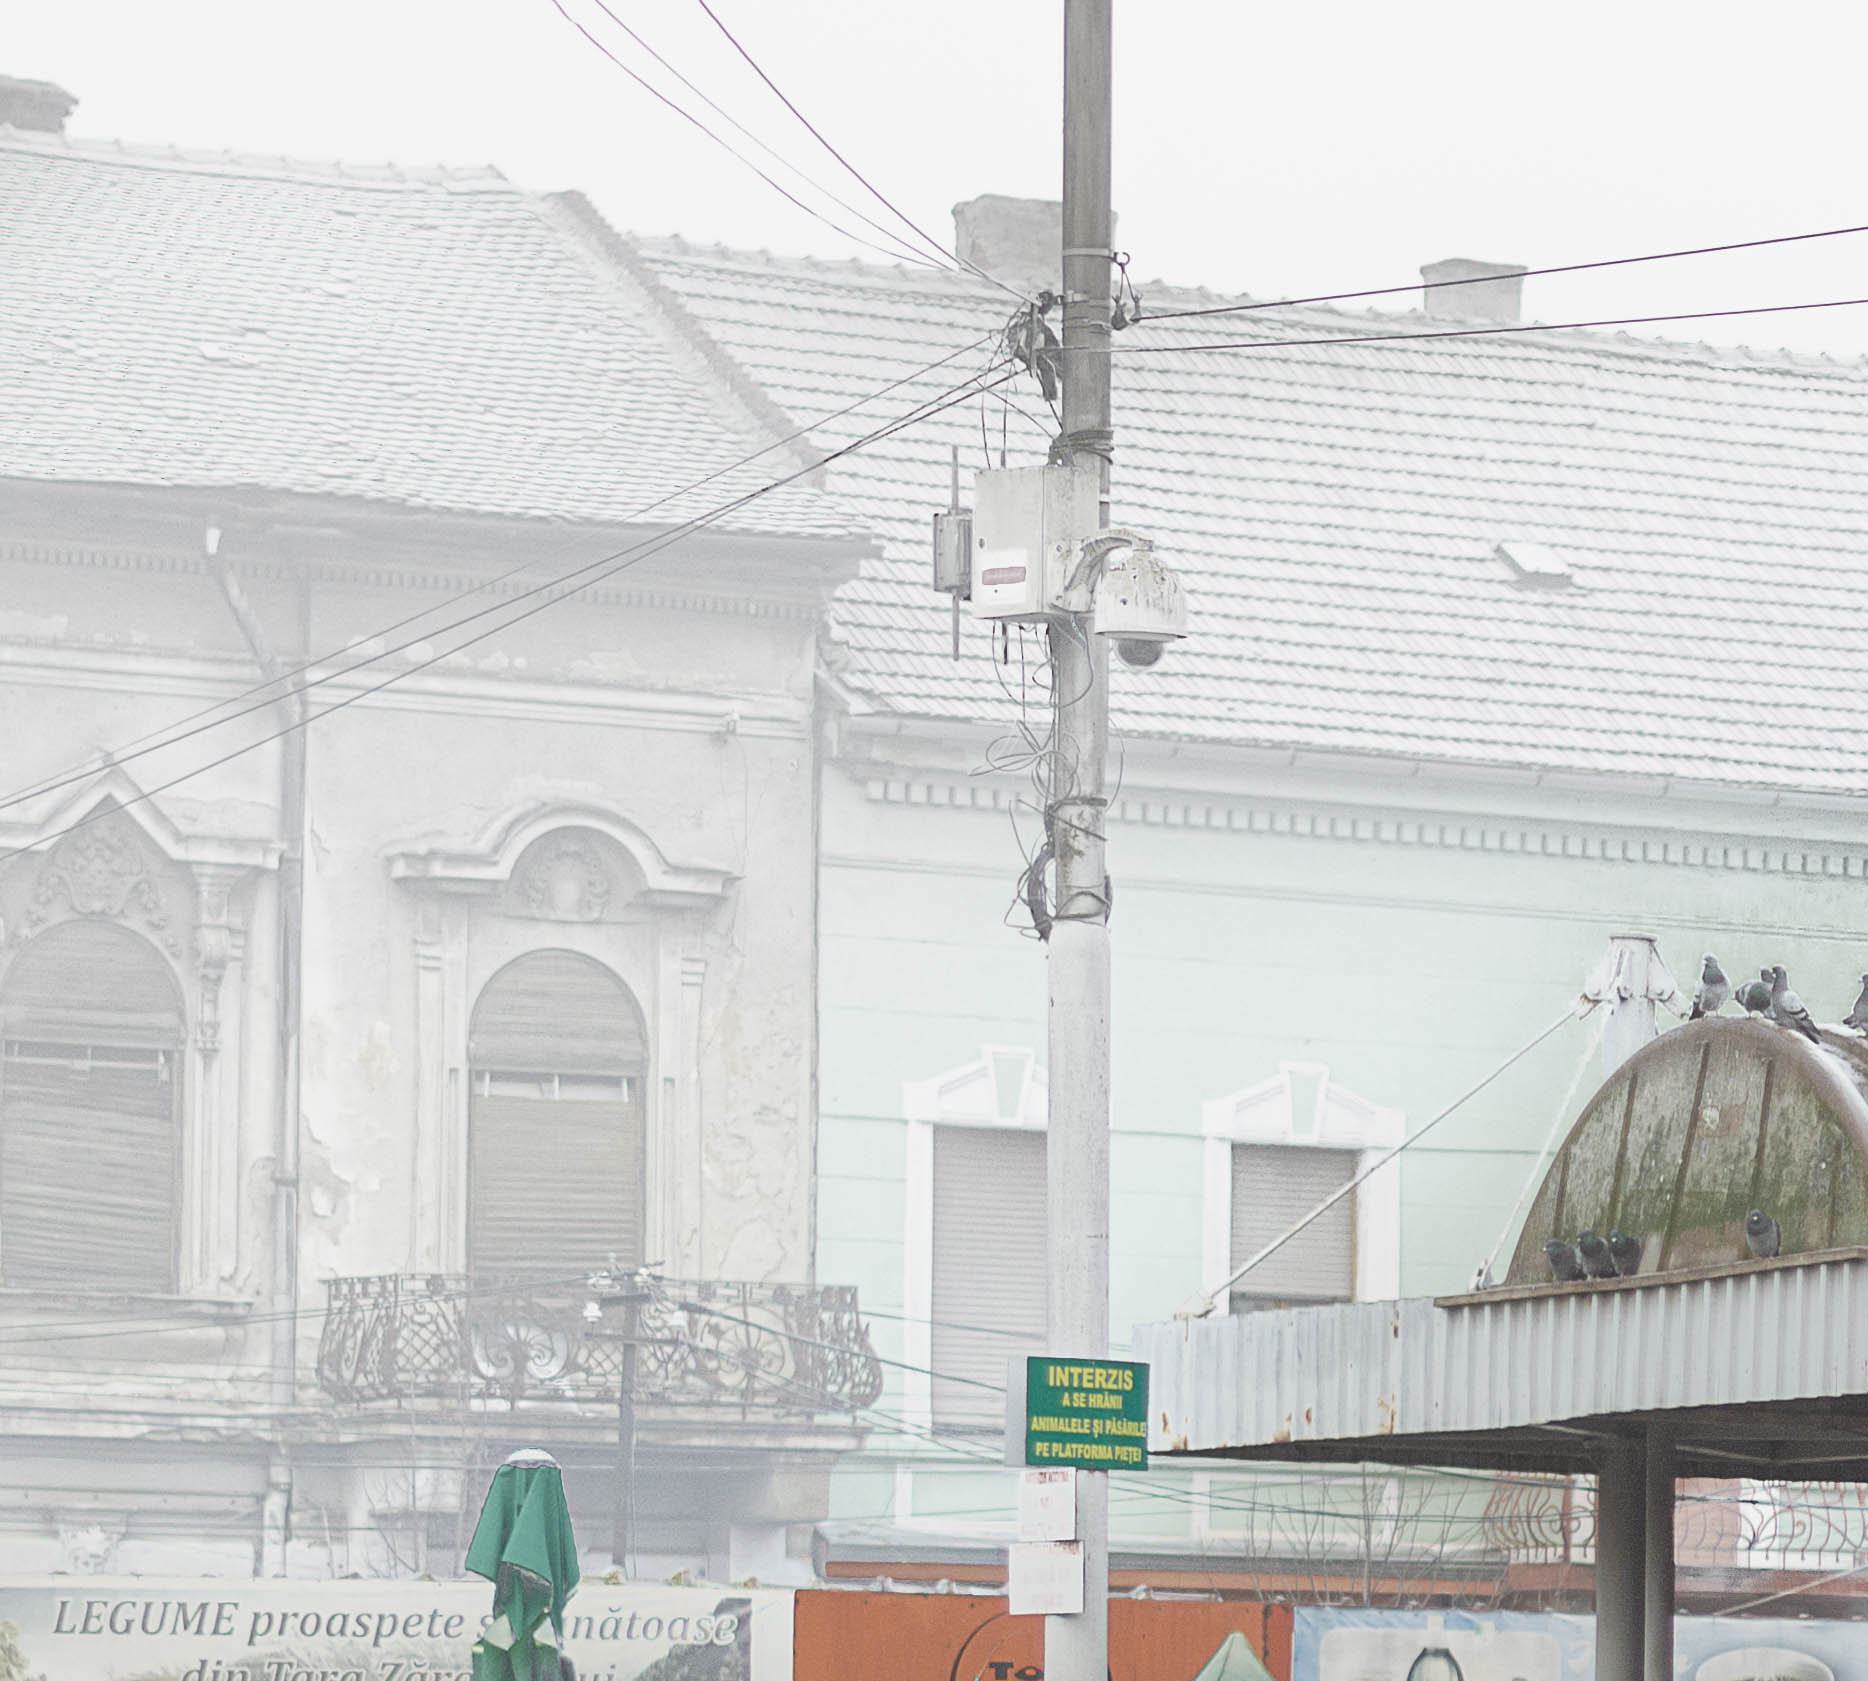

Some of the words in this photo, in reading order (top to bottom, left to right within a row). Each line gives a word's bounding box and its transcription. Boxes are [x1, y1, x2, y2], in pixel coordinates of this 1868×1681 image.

[1048, 1366, 1134, 1390] INTERZIS
[1062, 1394, 1070, 1406] A
[1073, 1395, 1086, 1408] SE
[1031, 1417, 1091, 1434] ANIMALELE
[1035, 1442, 1050, 1458] PE
[1052, 1443, 1113, 1460] PLATFORMA
[53, 1600, 240, 1637] LEGUME
[248, 1608, 464, 1647] proaspete
